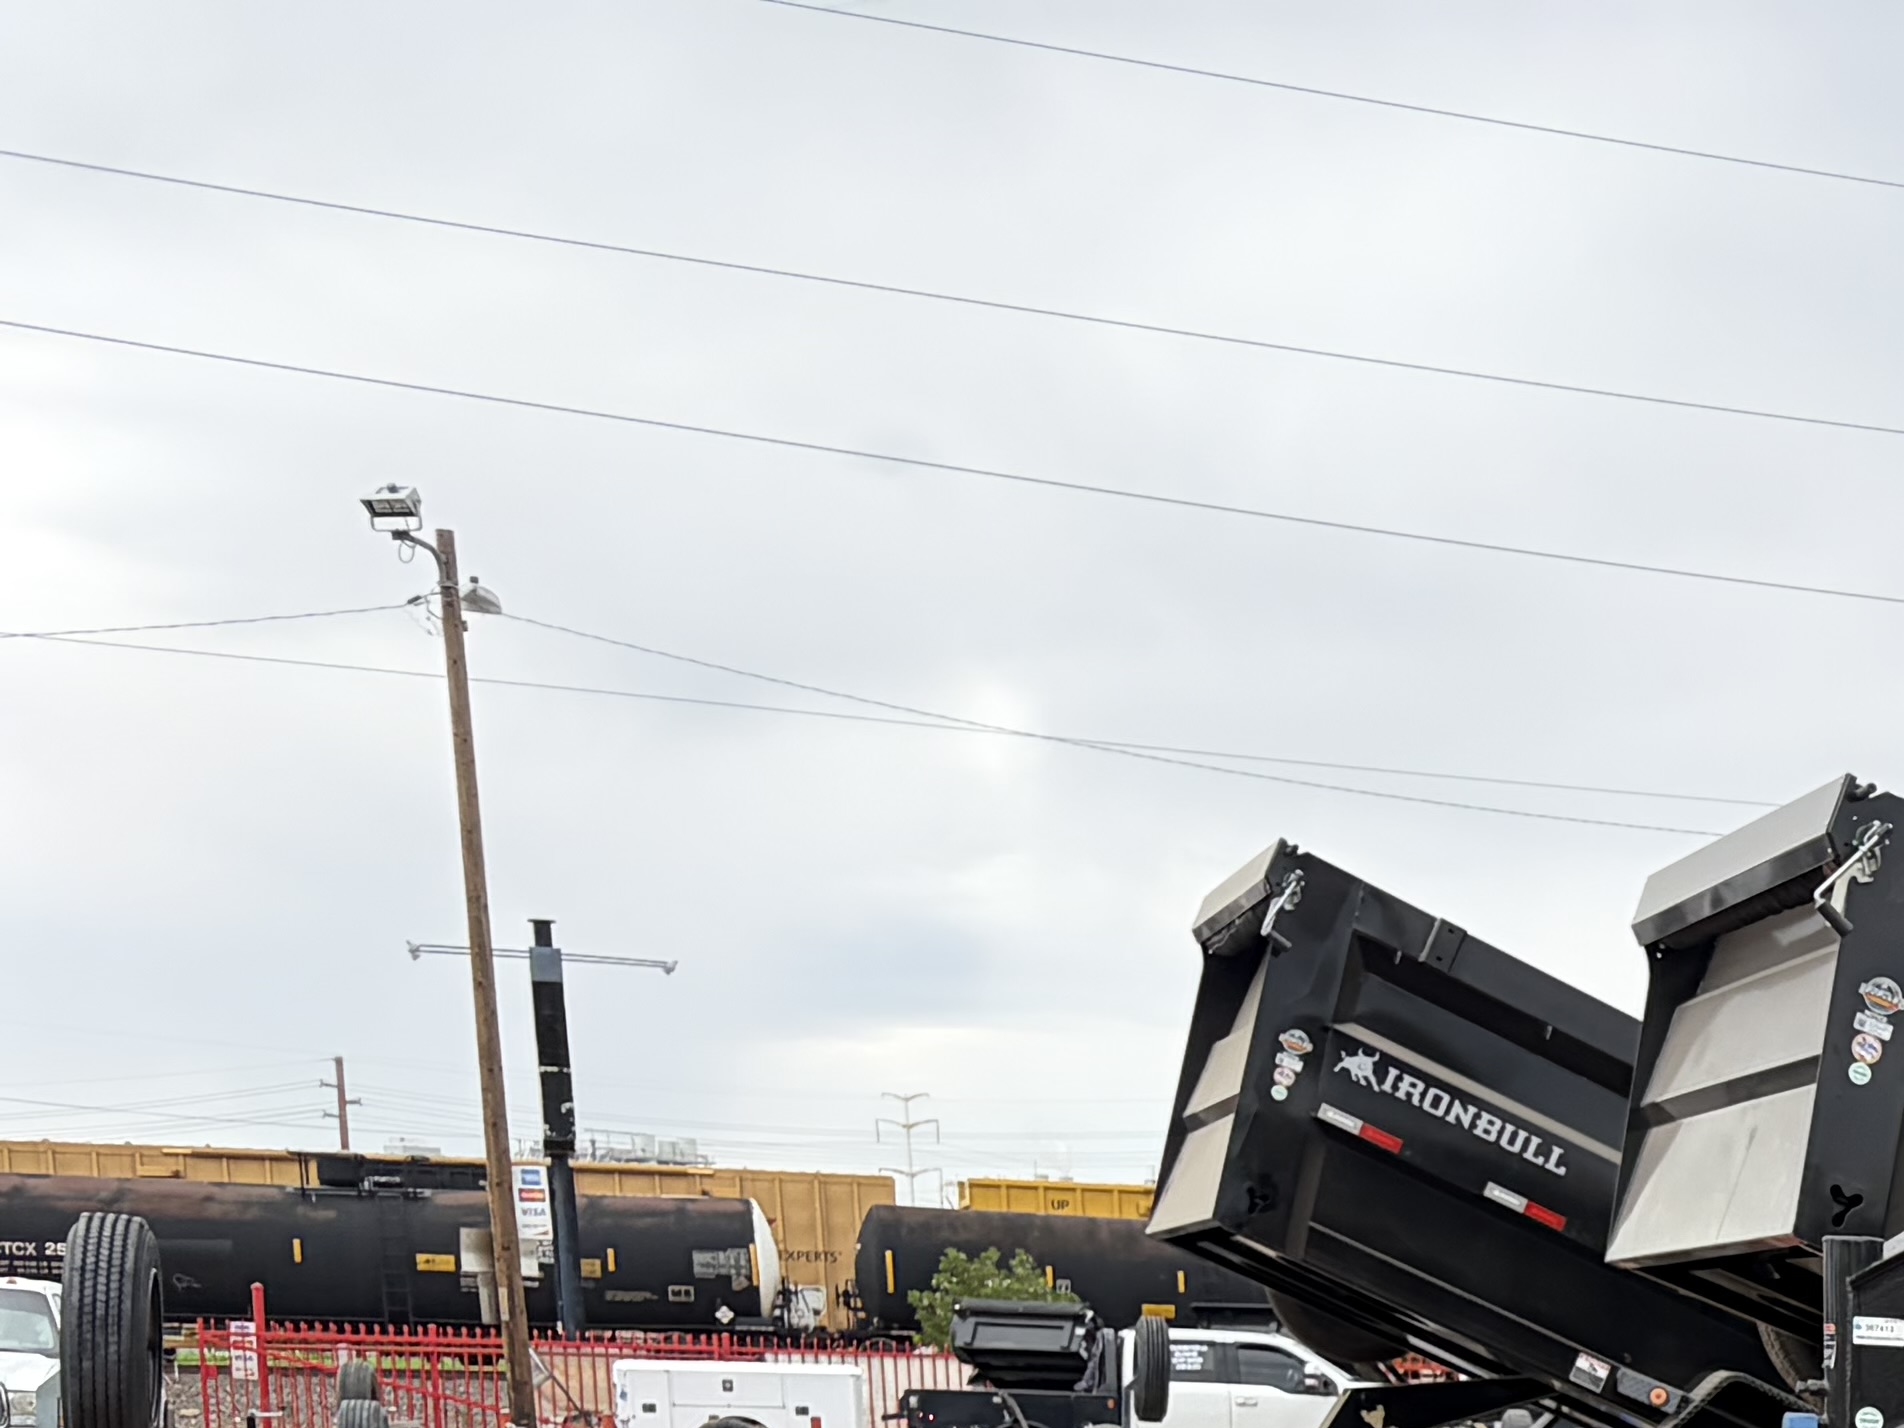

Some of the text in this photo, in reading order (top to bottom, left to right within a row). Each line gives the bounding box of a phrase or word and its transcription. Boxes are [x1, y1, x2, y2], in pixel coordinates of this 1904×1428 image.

[1380, 1065, 1568, 1176] IRONBULL
[521, 1207, 547, 1216] VISA
[1051, 1199, 1070, 1211] UP
[0, 1241, 37, 1256] TCX
